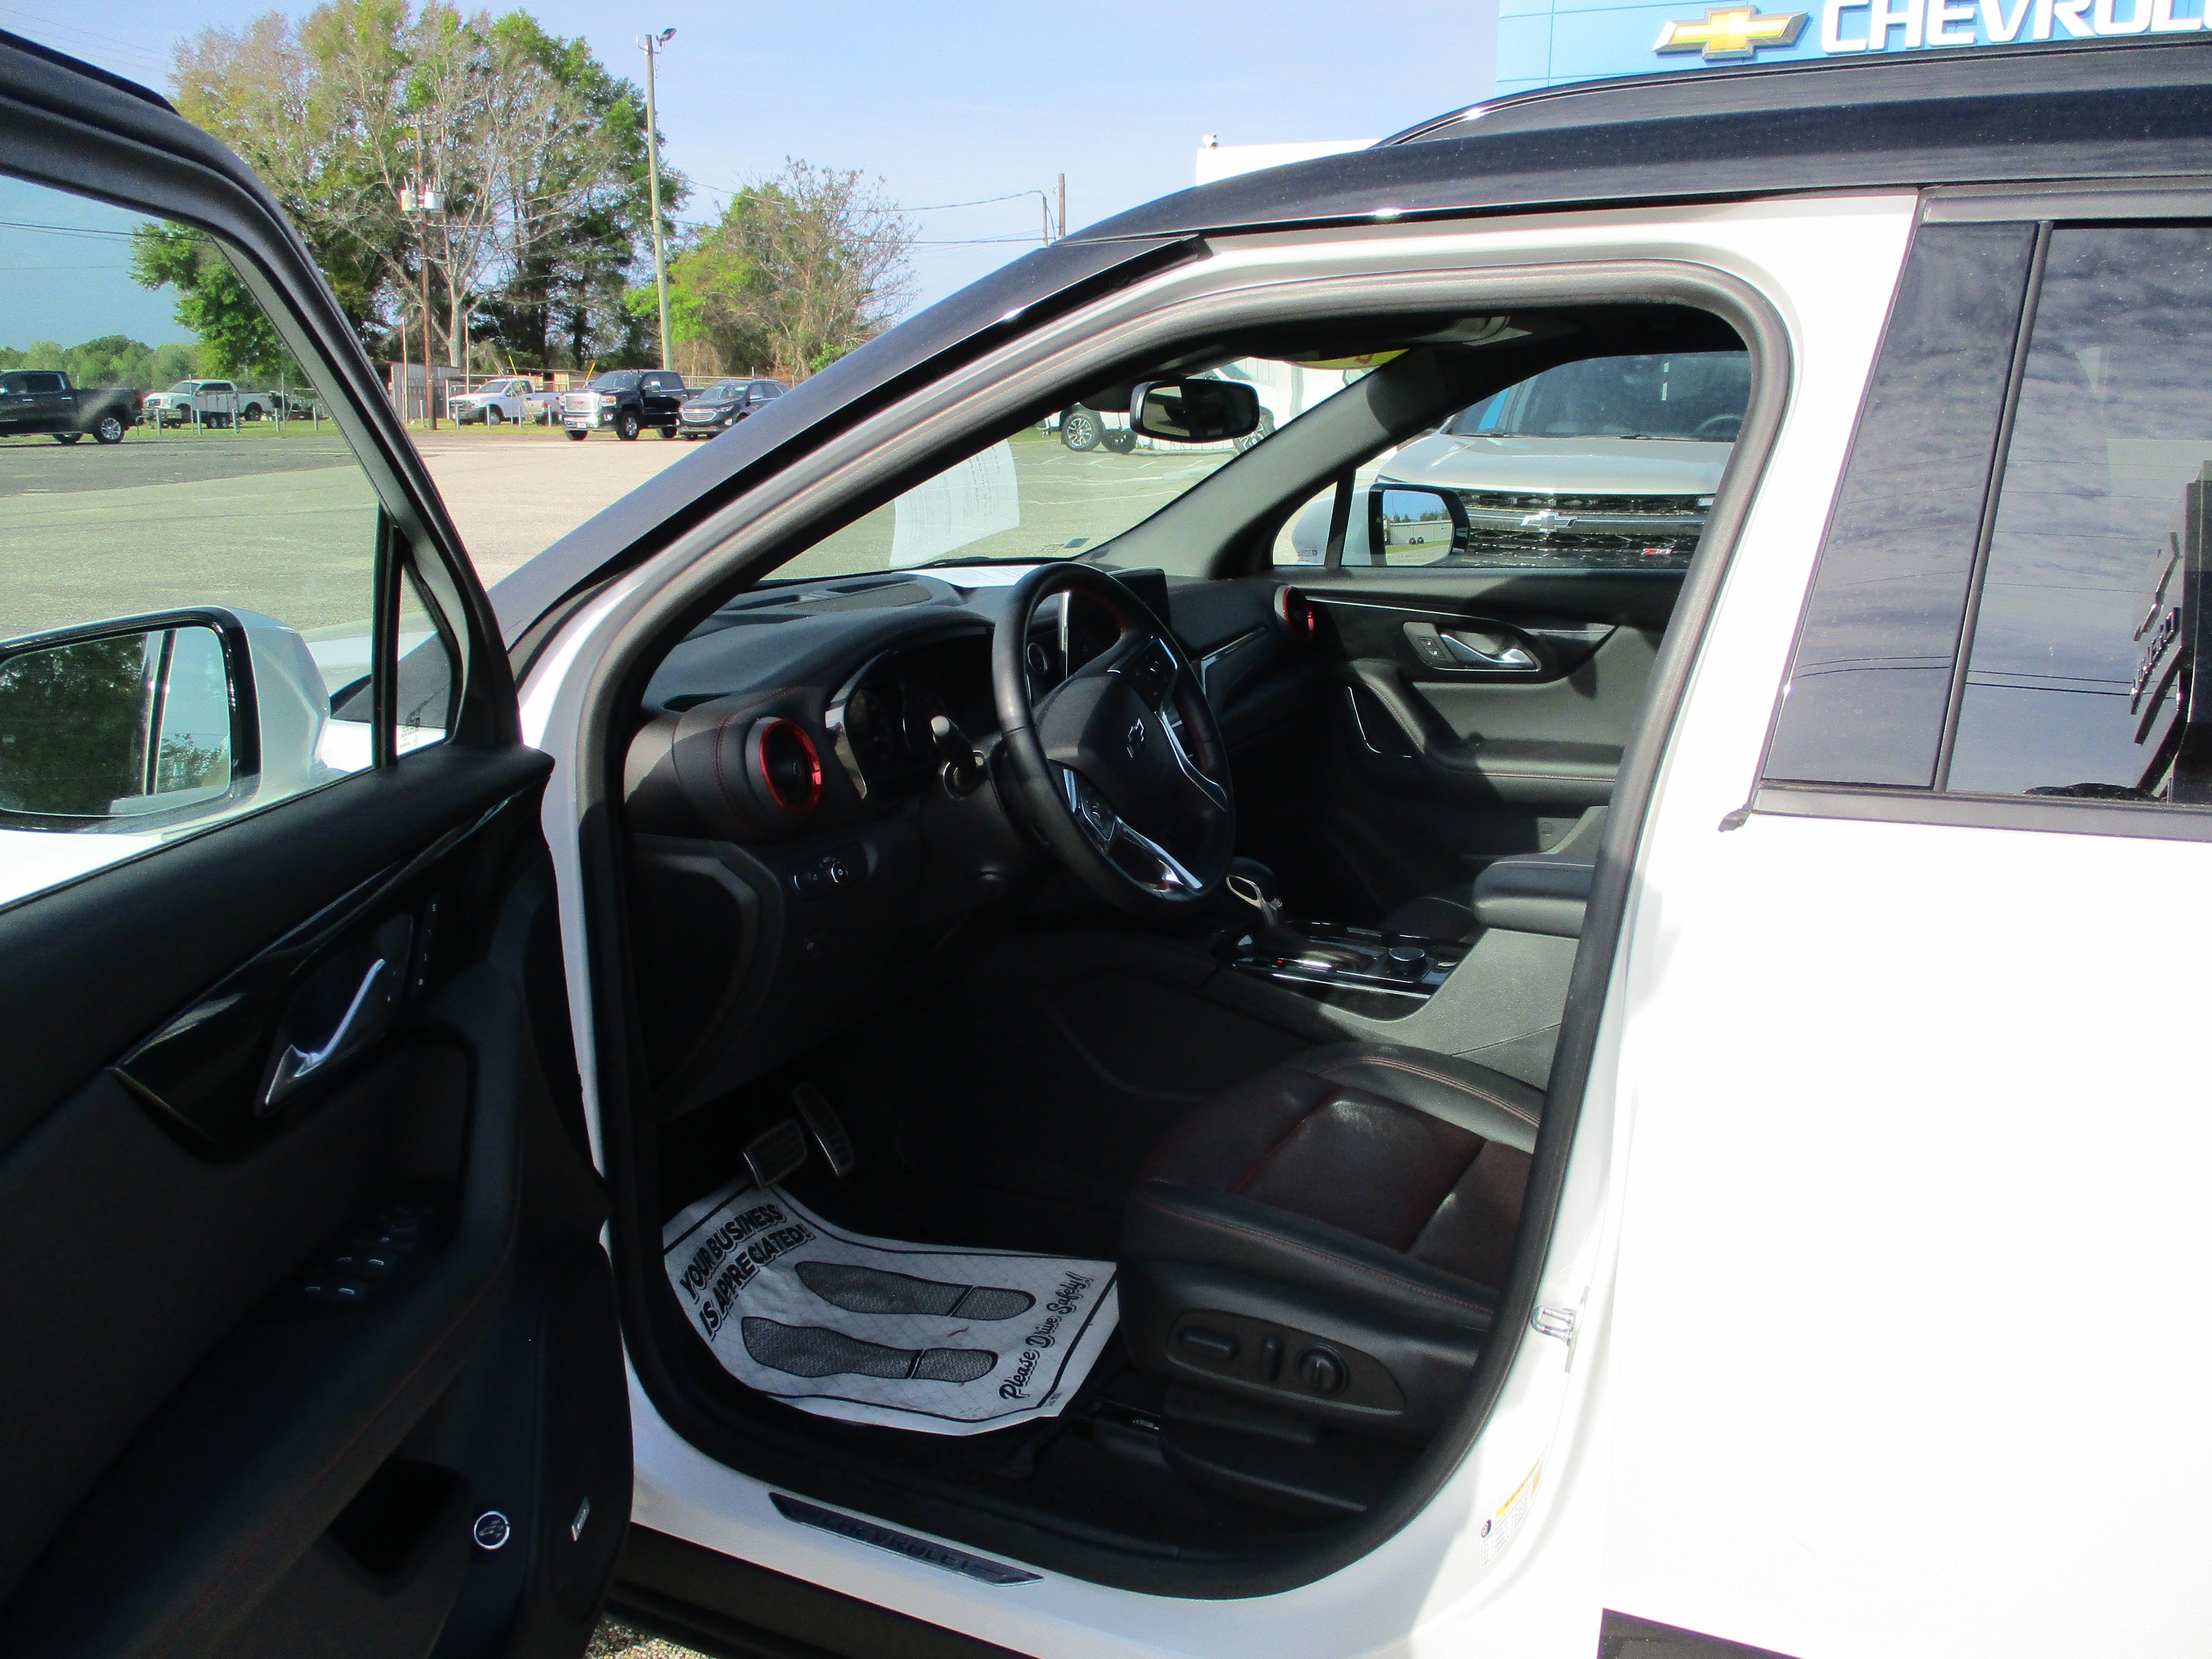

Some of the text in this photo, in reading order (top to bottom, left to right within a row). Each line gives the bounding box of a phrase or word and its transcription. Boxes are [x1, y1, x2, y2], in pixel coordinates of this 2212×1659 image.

[1821, 0, 2212, 53] CHEVROL
[679, 1203, 787, 1303] YOUR BUSINESS
[699, 1223, 815, 1341] IS APPRECIATED!
[999, 1350, 1039, 1399] Please
[1025, 1316, 1062, 1348] Drive
